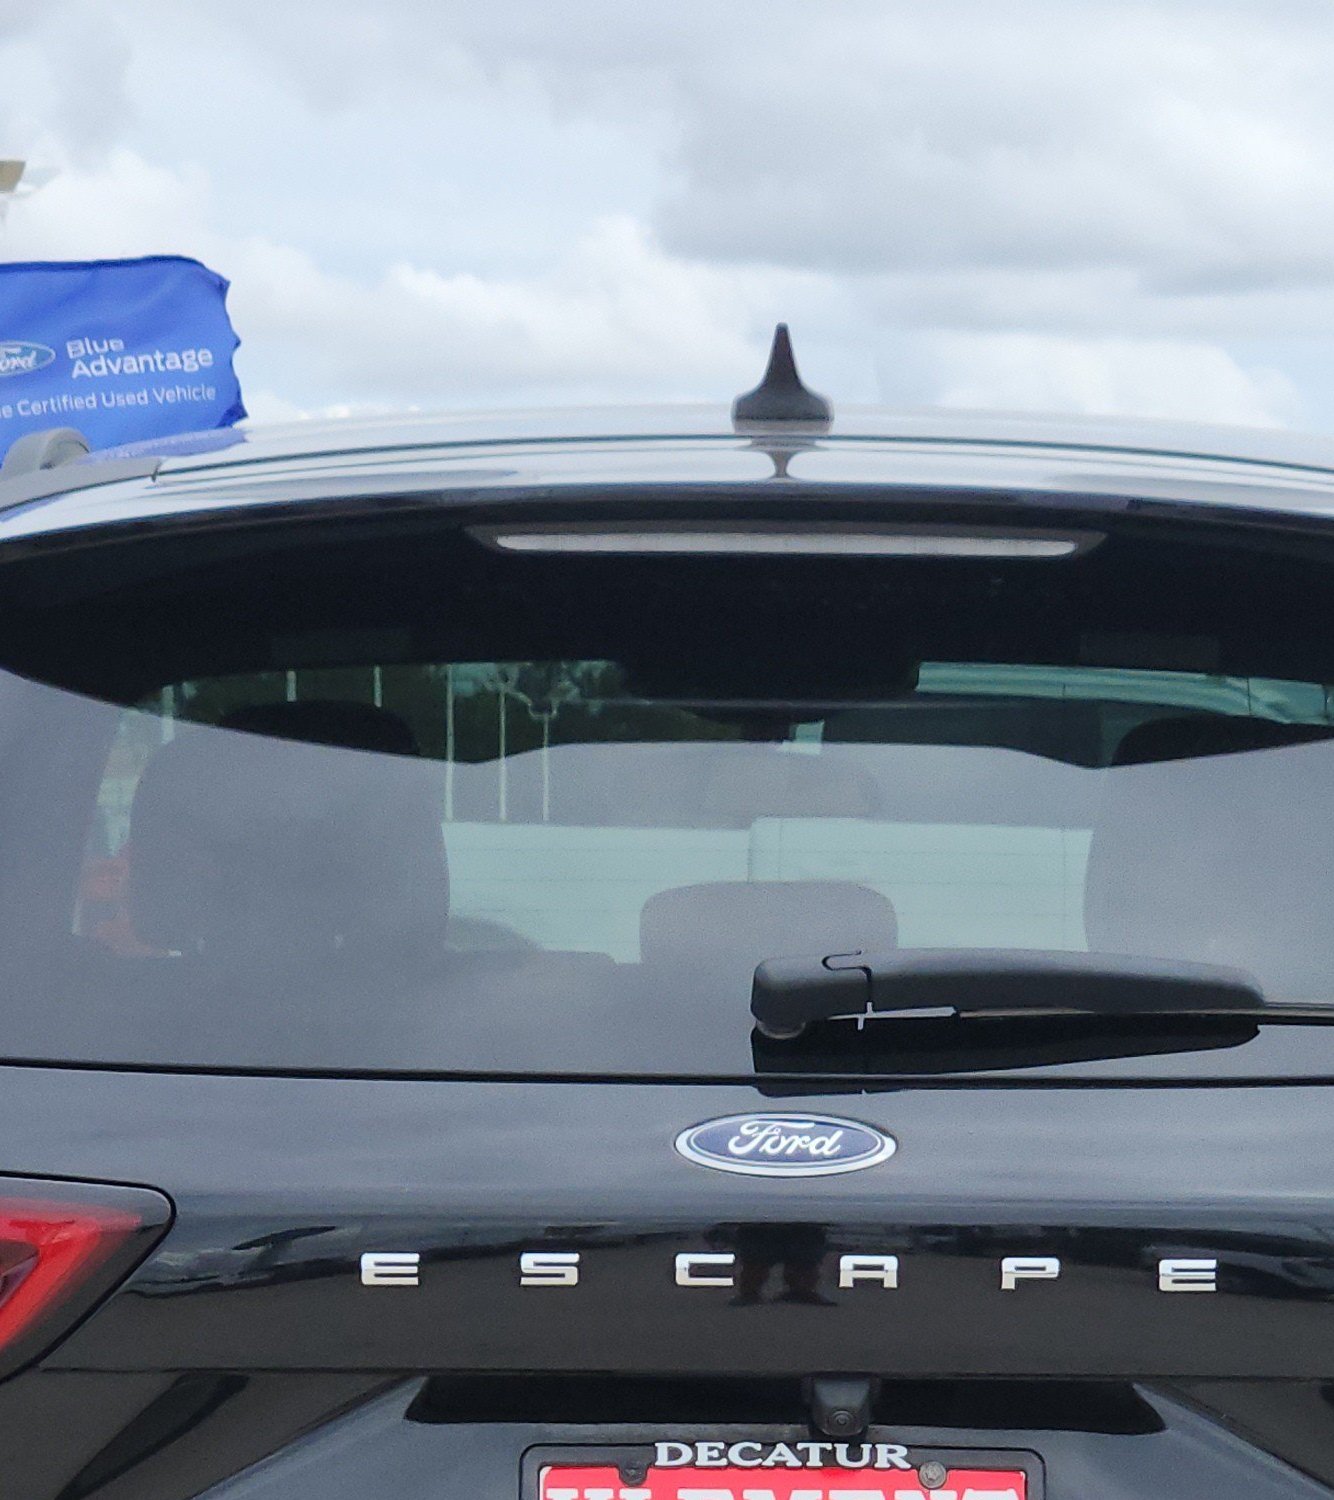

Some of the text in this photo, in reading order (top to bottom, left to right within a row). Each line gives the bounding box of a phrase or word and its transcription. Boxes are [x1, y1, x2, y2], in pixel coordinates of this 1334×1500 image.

[66, 337, 124, 359] Blue
[71, 347, 214, 379] Advantage
[17, 393, 97, 417] Certified
[101, 388, 149, 408] Used
[152, 383, 216, 405] Vehicle
[728, 1120, 844, 1156] Ford
[360, 1252, 1218, 1293] ESCAPE
[654, 1441, 913, 1470] DECATUR
